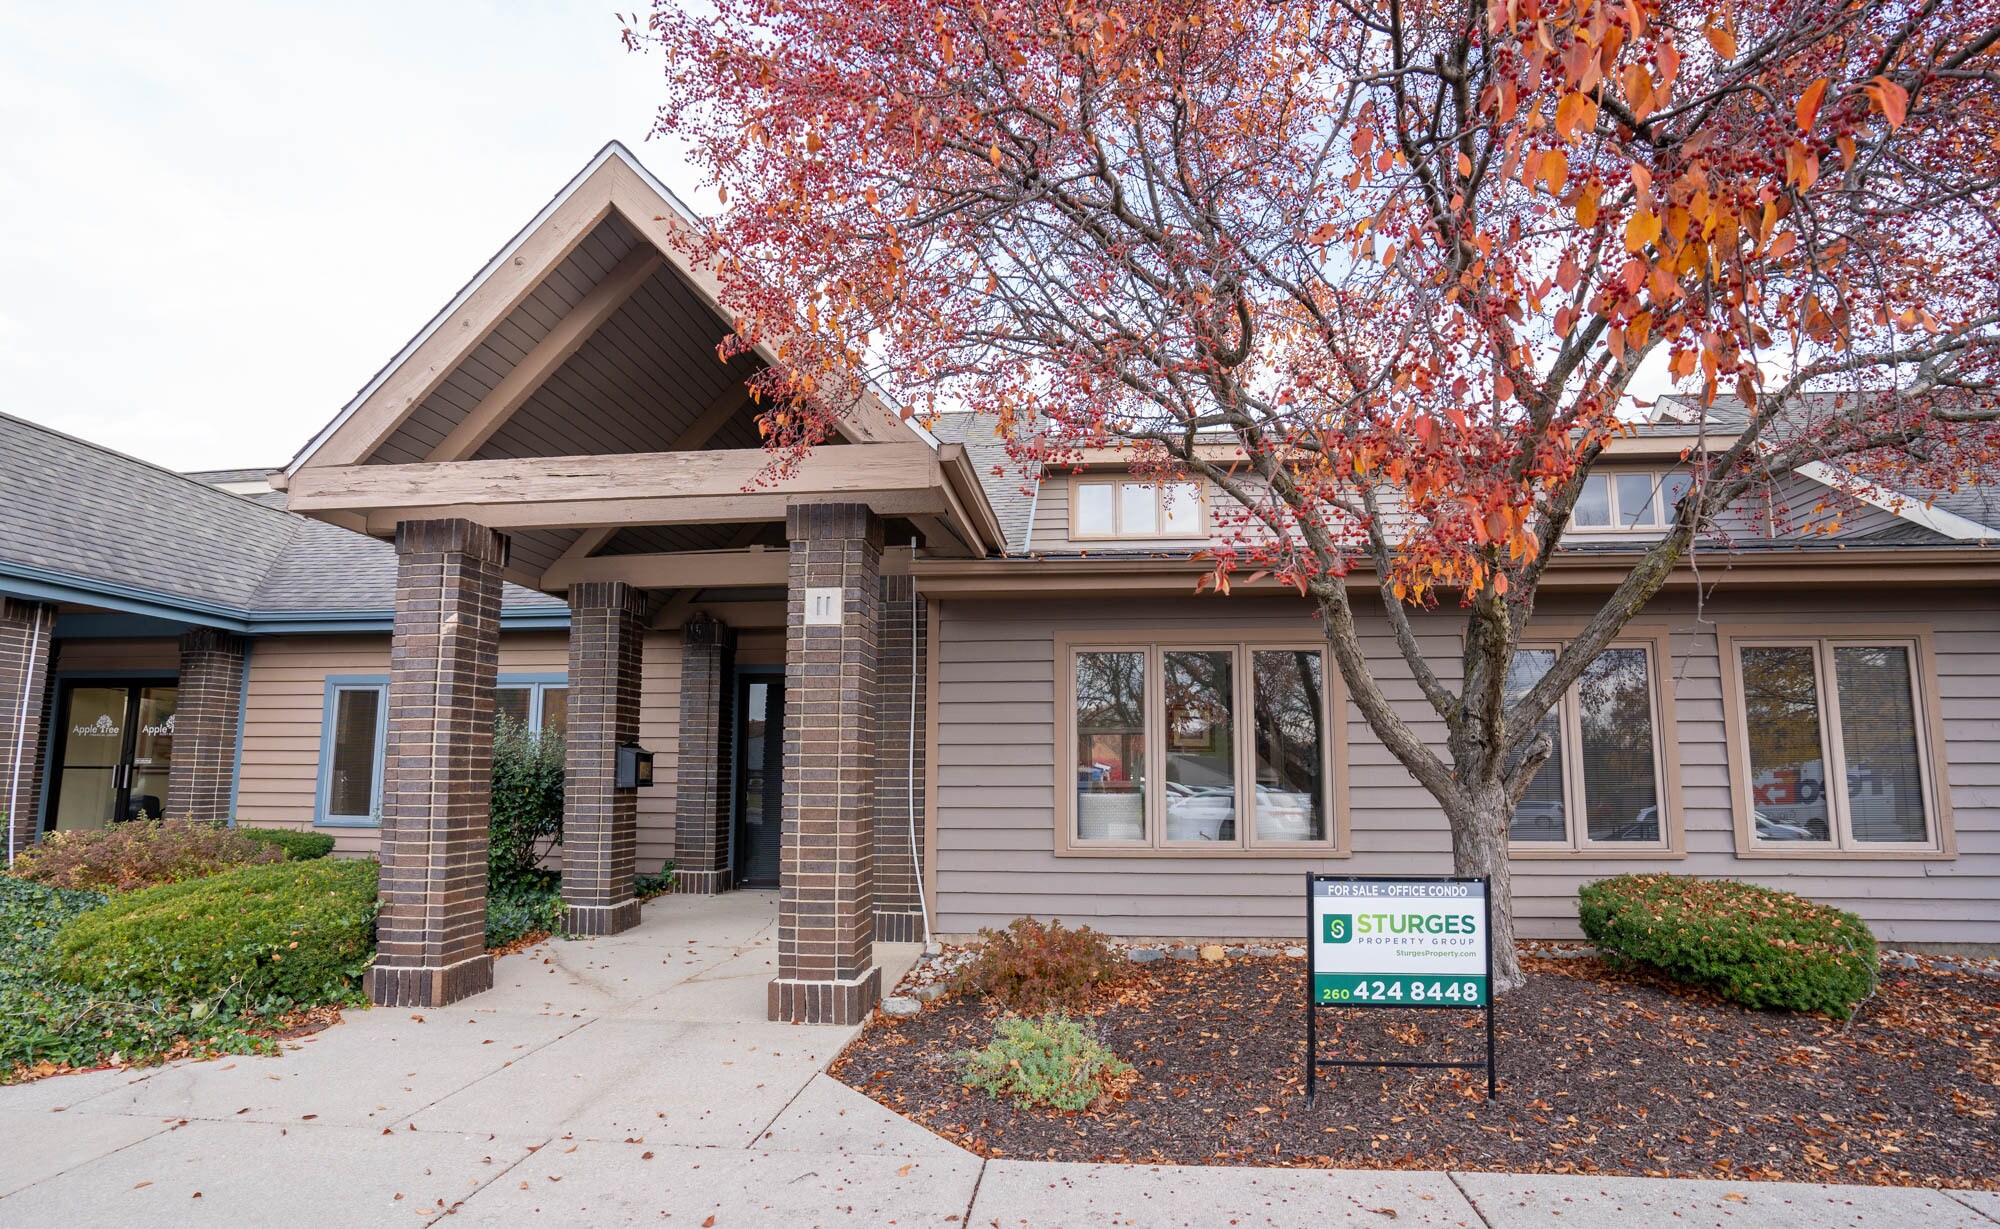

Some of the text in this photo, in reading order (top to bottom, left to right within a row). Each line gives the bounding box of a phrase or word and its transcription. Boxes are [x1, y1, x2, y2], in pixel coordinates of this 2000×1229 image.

[816, 596, 831, 617] 11
[73, 724, 120, 736] Apple Tree
[142, 723, 168, 736] Apple
[1328, 885, 1350, 896] FOR
[1352, 885, 1379, 896] SALE
[1387, 885, 1426, 896] OFFICE
[1428, 885, 1468, 897] CONDO
[1357, 913, 1476, 934] STURGES
[1358, 937, 1475, 946] PROPERTY GROUP
[1396, 949, 1477, 958] SturgesProperty.com
[1322, 981, 1478, 1002] 260 424 8448
